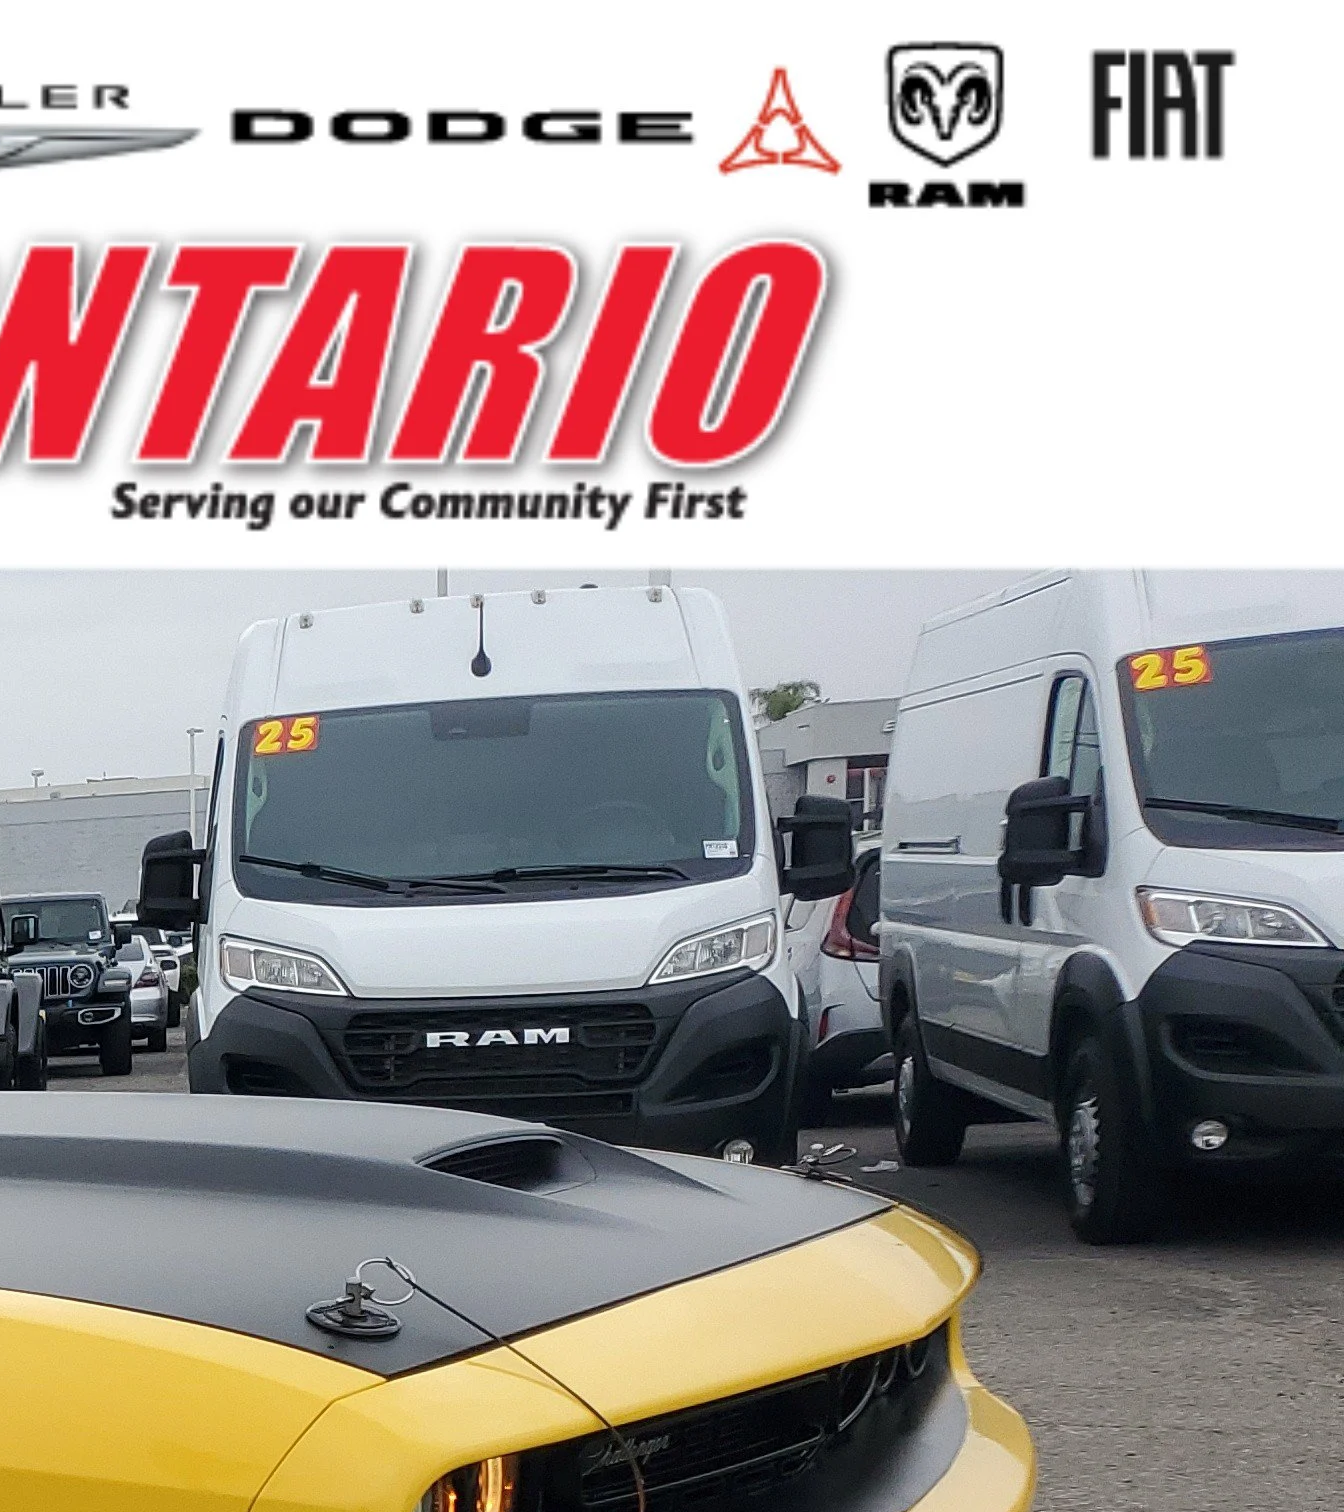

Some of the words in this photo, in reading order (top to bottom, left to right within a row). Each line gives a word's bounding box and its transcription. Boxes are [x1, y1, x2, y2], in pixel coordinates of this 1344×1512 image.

[1130, 646, 1207, 690] 25
[254, 716, 316, 755] 25
[426, 1027, 570, 1048] RAM
